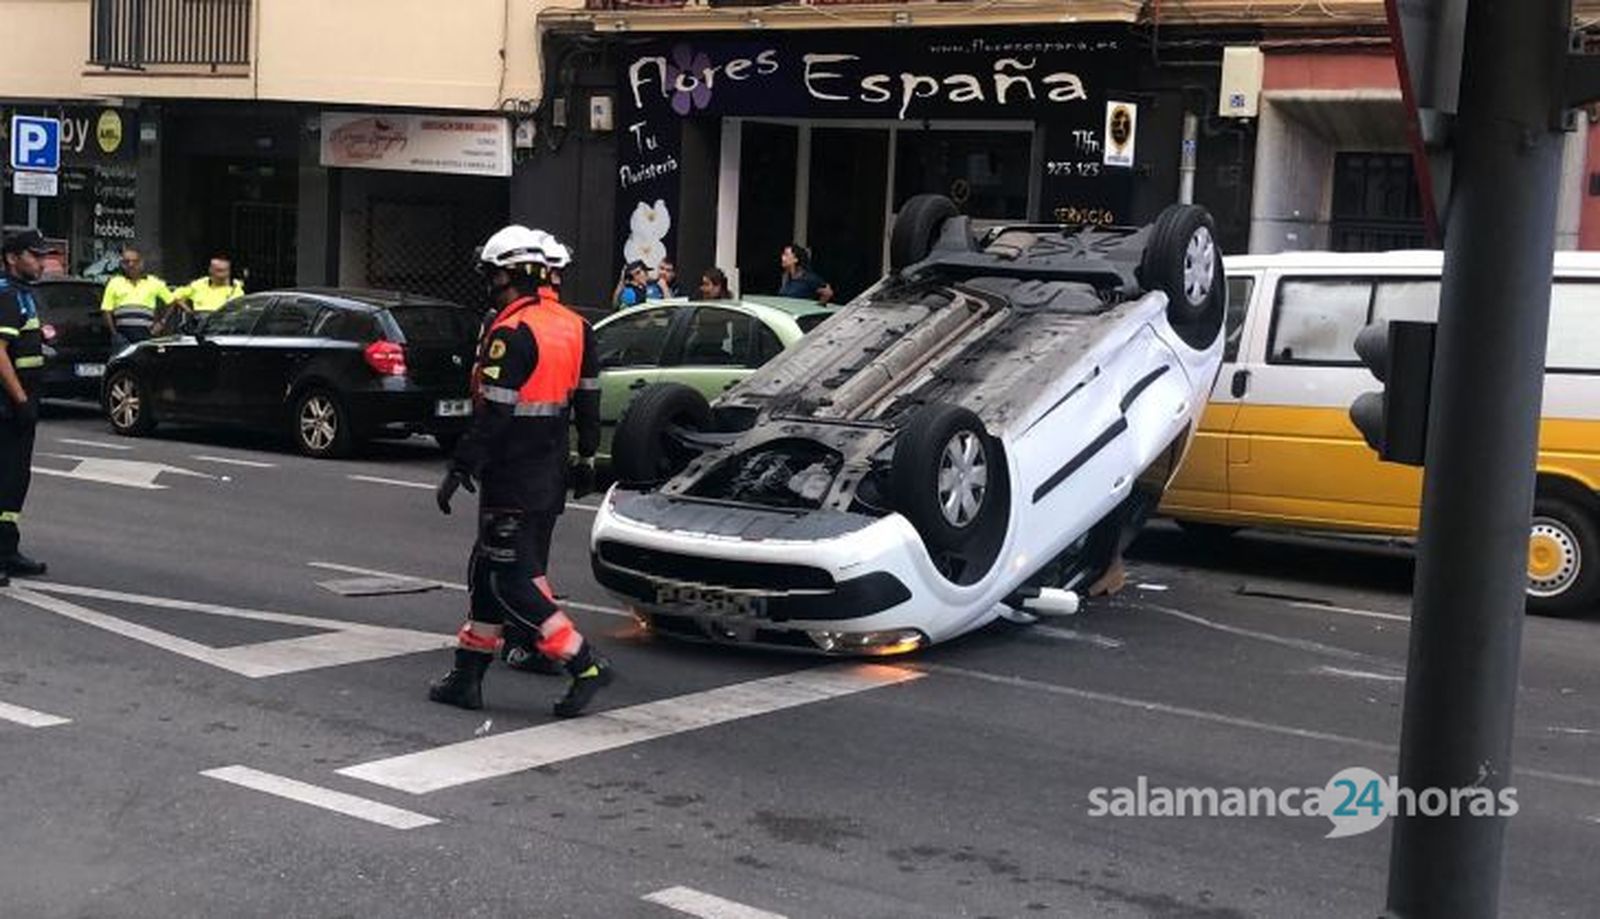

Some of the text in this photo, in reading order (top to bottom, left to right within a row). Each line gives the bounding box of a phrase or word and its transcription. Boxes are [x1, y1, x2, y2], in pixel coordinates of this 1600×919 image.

[629, 50, 1087, 120] Flores España
[19, 123, 47, 163] P
[629, 121, 657, 150] Tu
[1047, 161, 1100, 176] 923 123
[94, 217, 136, 238] hobbies
